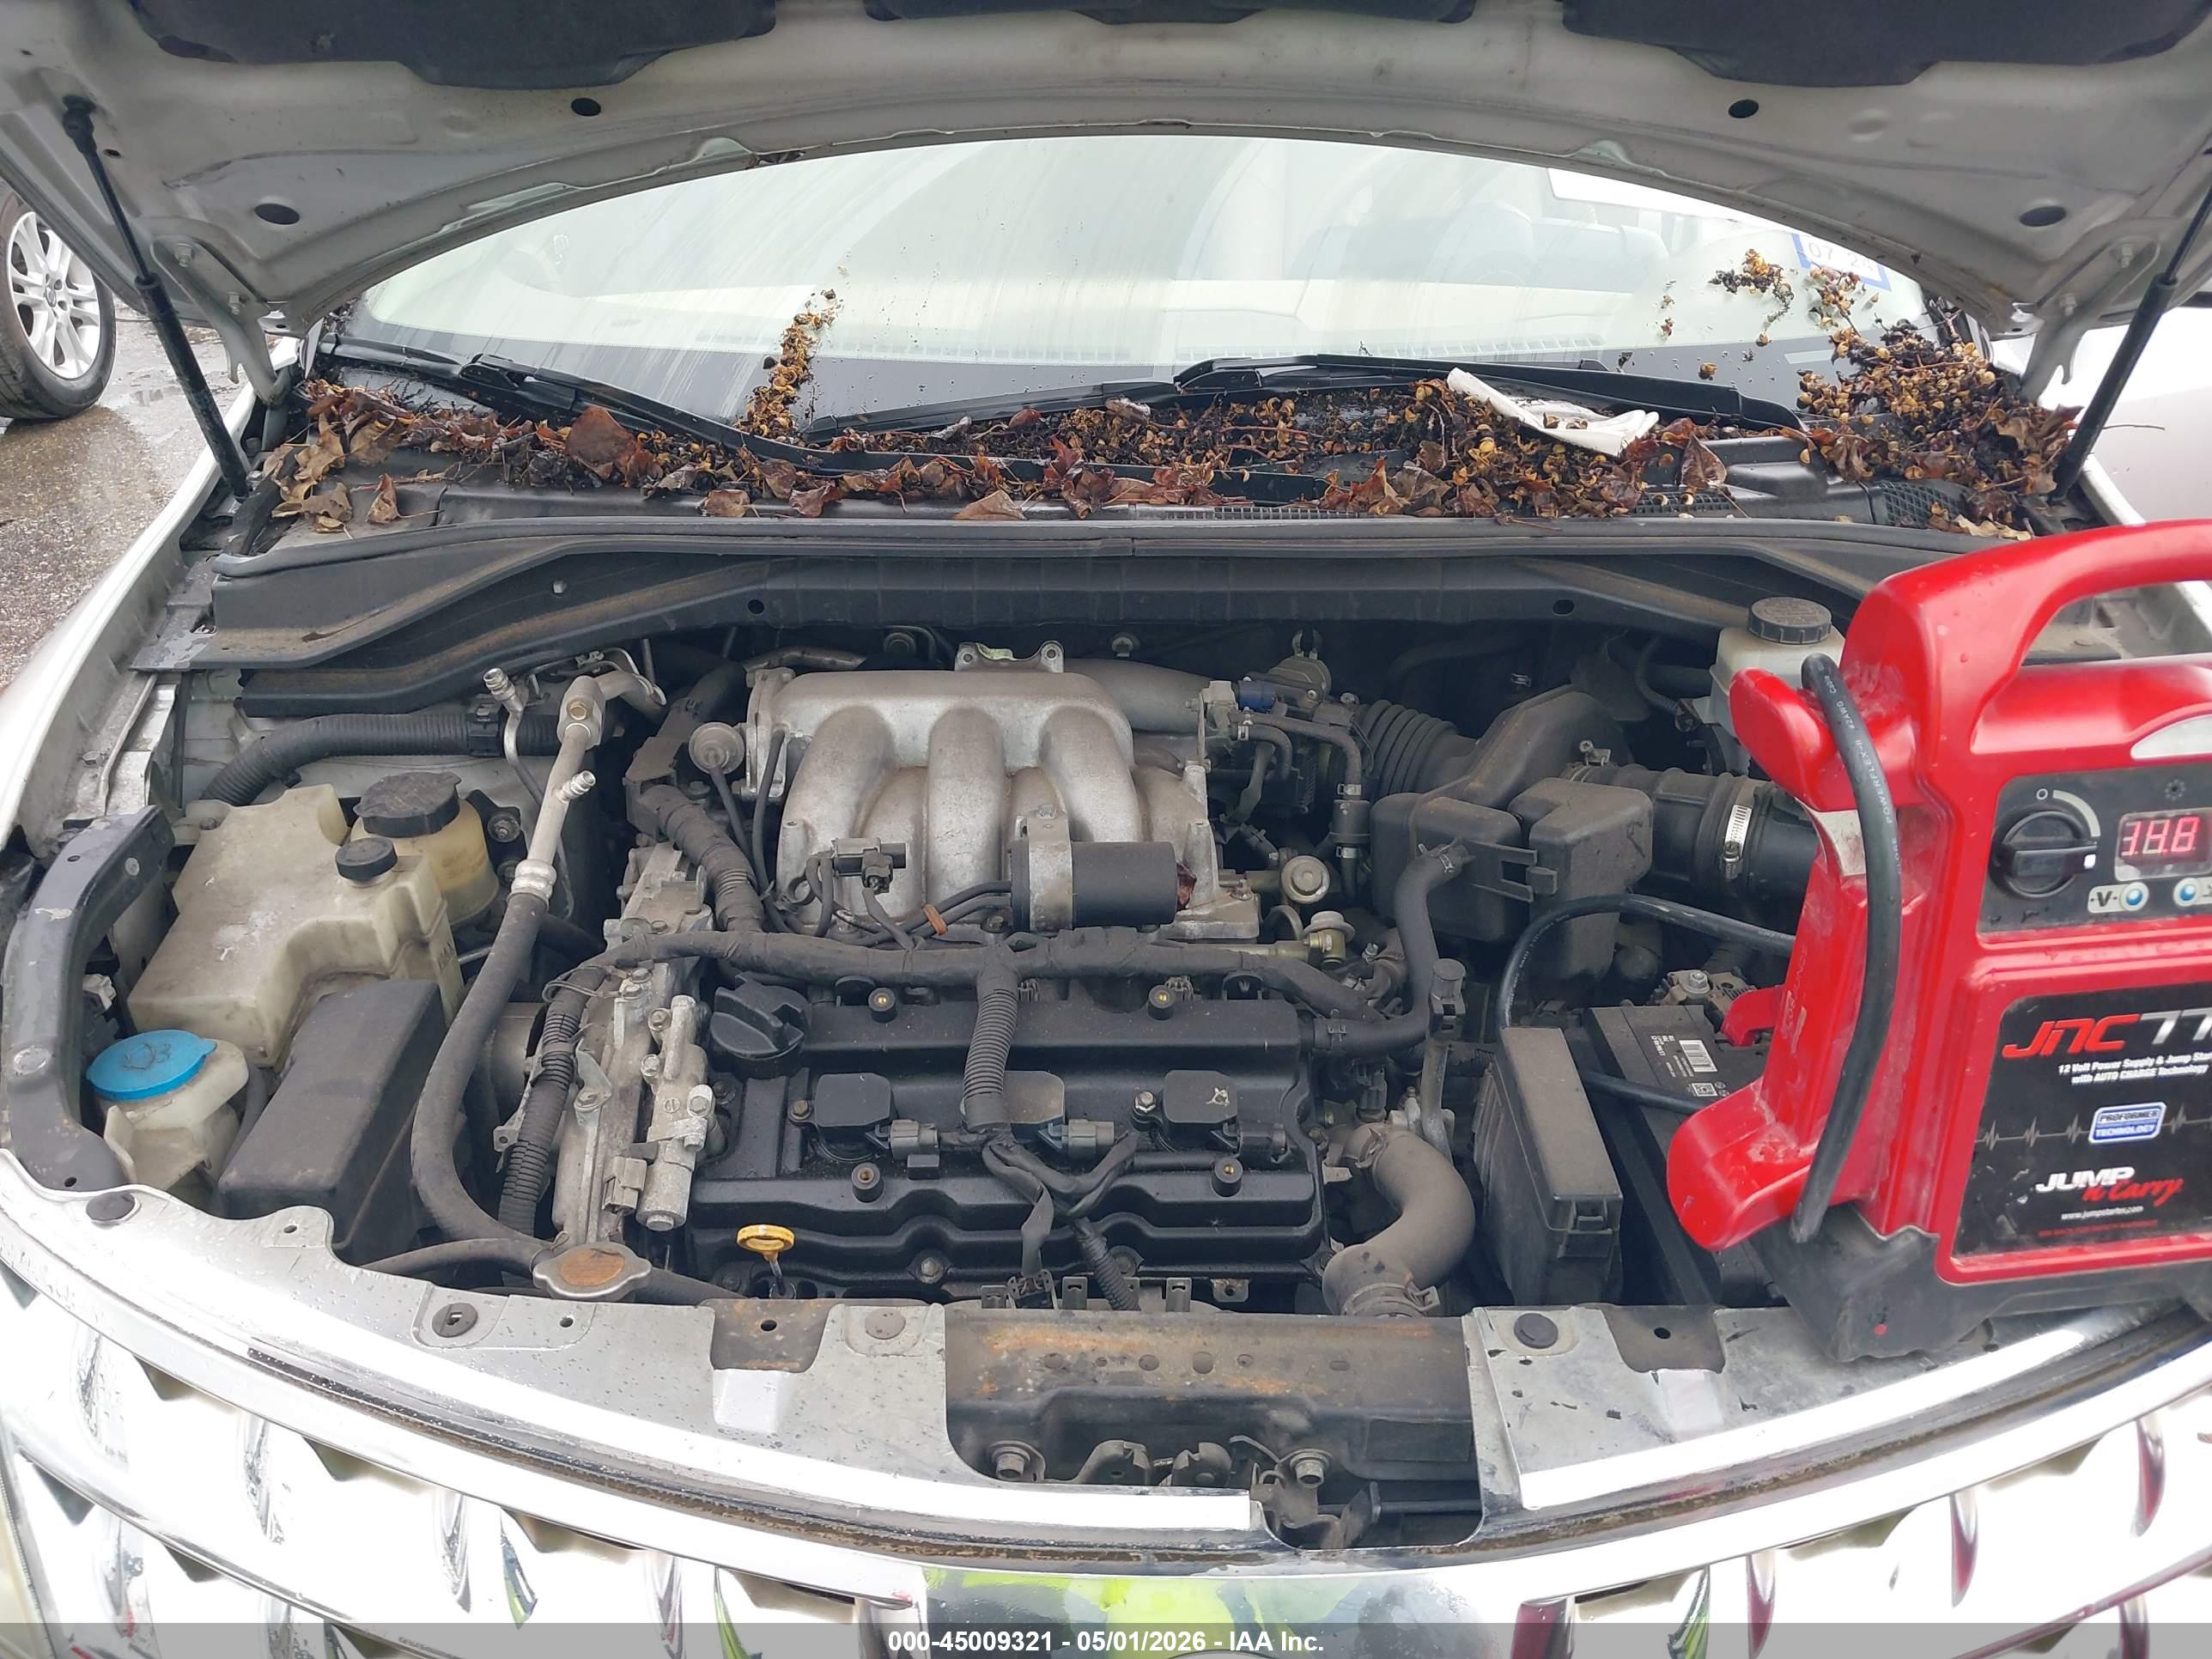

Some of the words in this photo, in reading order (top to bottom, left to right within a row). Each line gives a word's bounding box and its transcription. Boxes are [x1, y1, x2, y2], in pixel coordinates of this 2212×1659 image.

[1809, 242, 1833, 260] 07
[2002, 1006, 2212, 1059] JNC77
[2057, 1064, 2071, 1075] 12
[2072, 1061, 2091, 1073] Volt
[2092, 1060, 2122, 1072] Power
[2122, 1057, 2154, 1070] Supply
[2165, 1054, 2192, 1065] Jump
[2192, 1051, 2212, 1062] Star
[2071, 1073, 2094, 1085] with
[2094, 1071, 2119, 1083] AUTO
[2119, 1067, 2158, 1080] CHARGE
[2158, 1064, 2209, 1079] Technology
[2095, 1124, 2154, 1138] TECHNOLOGY
[2035, 1165, 2136, 1193] JUMP
[2108, 1177, 2185, 1207] Carry
